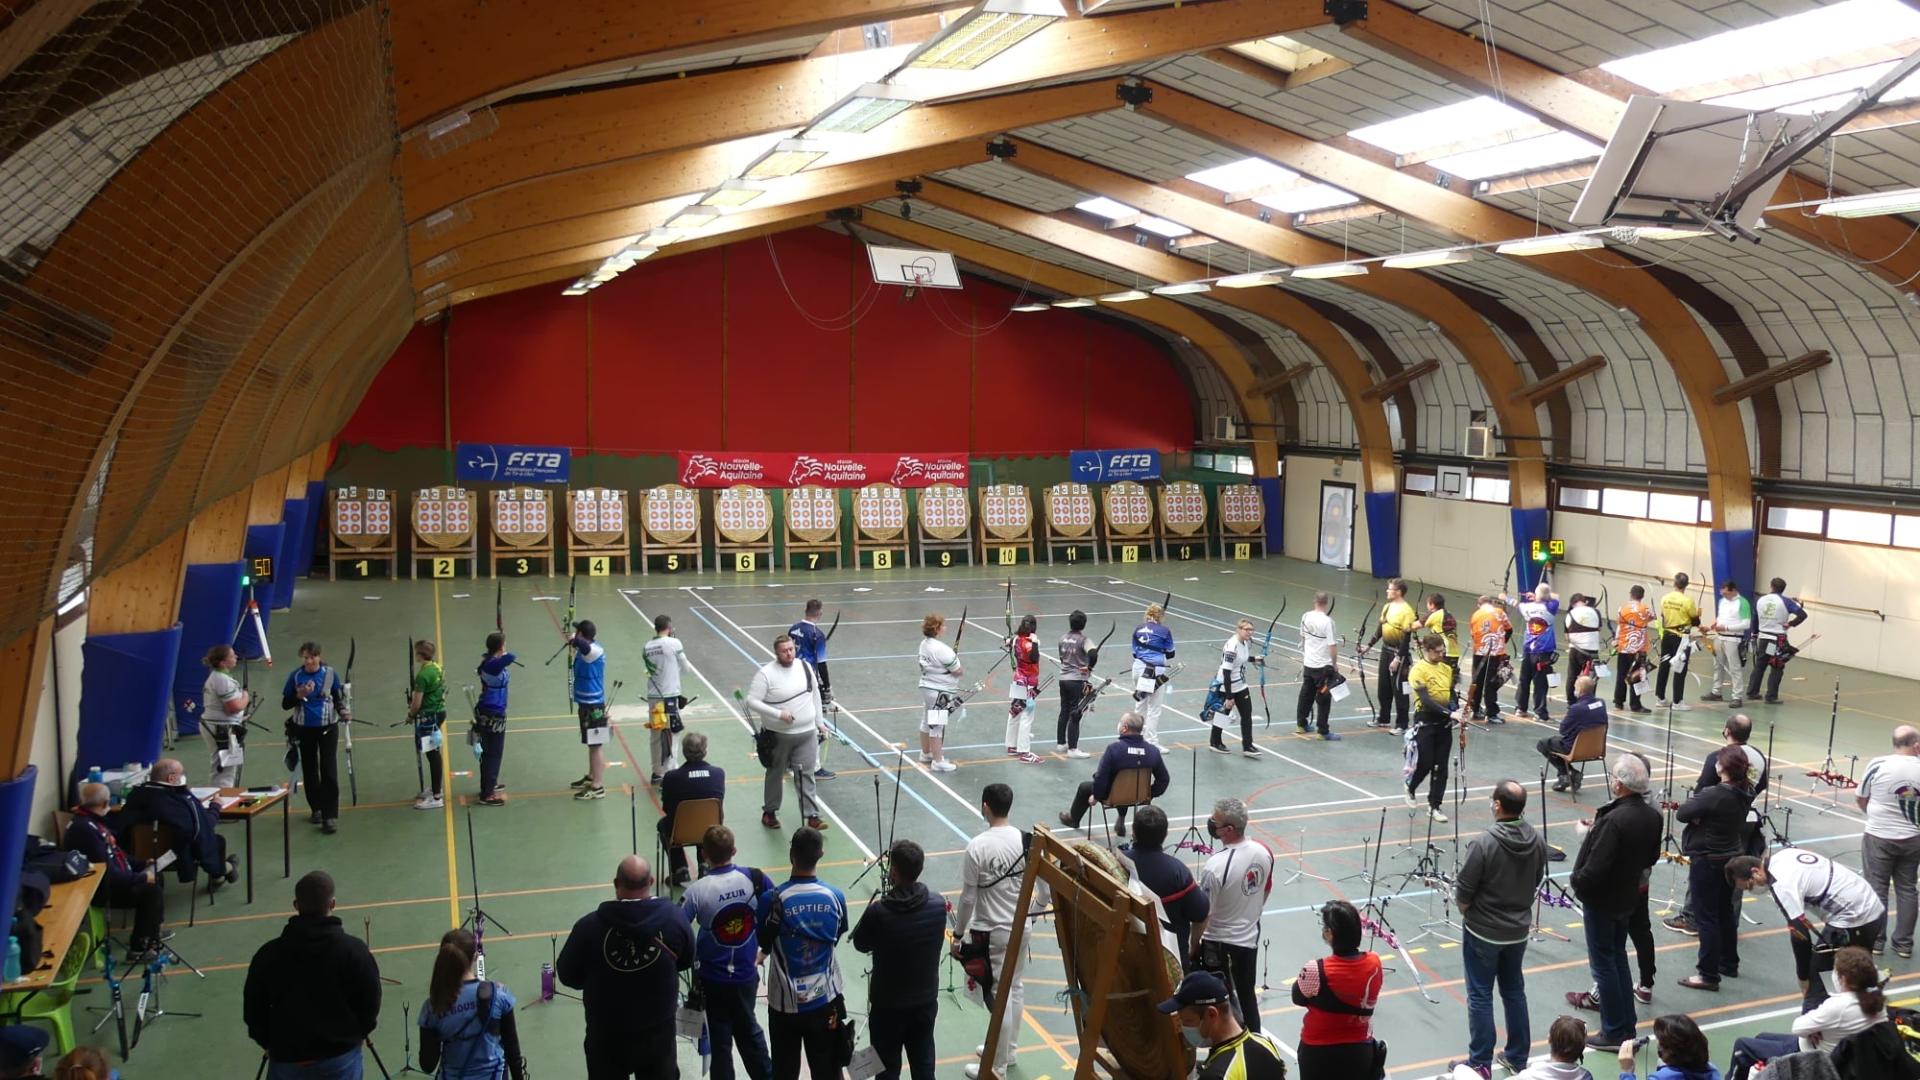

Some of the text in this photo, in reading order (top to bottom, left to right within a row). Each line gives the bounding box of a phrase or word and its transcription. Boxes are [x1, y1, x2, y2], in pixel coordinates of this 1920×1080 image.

[720, 462, 764, 471] Nouvelle-
[824, 463, 866, 472] Nouvelle-
[925, 463, 965, 471] Nouvelle-
[720, 471, 763, 482] Aquitaine
[824, 472, 866, 483] Aquitaine
[925, 471, 965, 481] Aquitaine
[1066, 547, 1076, 560] 11
[1126, 547, 1135, 560] 12
[1181, 547, 1190, 560] 13
[1238, 546, 1247, 558] 14
[1550, 540, 1564, 555] 50
[741, 555, 750, 568] 6
[808, 554, 819, 569] 7
[878, 553, 887, 566] 8
[941, 553, 950, 566] 9
[1002, 548, 1013, 562] 10
[255, 558, 271, 576] 50
[355, 560, 368, 576] 1
[438, 560, 450, 575] 2
[517, 559, 528, 574] 3
[593, 560, 604, 573] 4
[667, 555, 679, 570] 5
[718, 889, 746, 902] AZUR
[784, 903, 832, 917] SEPTIER
